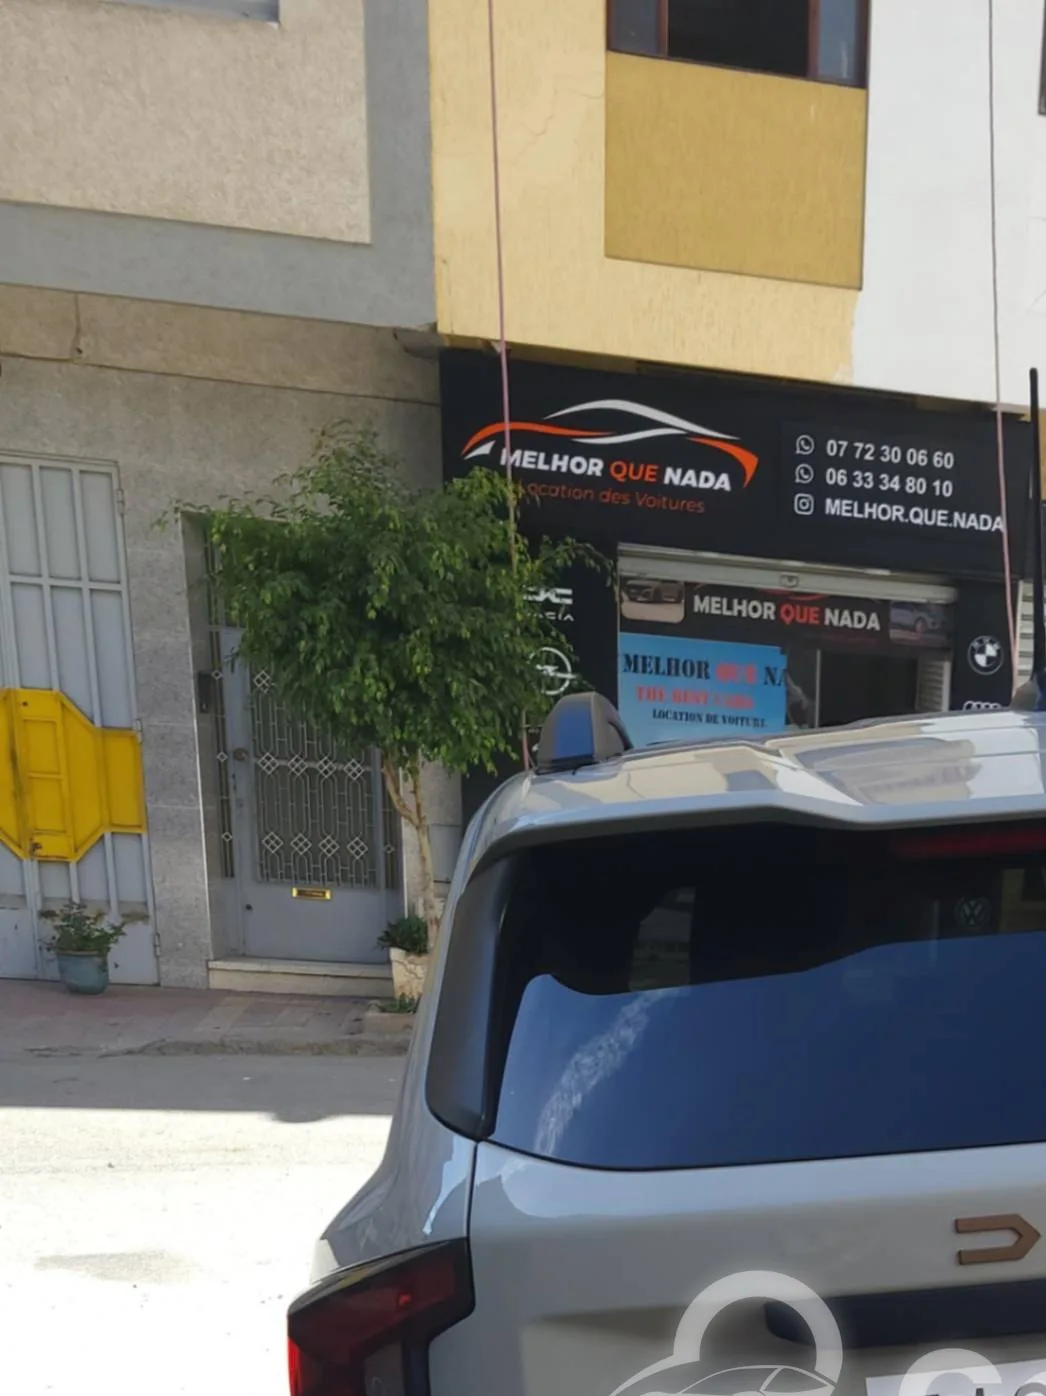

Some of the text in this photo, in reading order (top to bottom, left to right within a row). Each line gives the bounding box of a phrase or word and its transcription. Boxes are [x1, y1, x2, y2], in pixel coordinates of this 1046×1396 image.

[826, 440, 955, 469] 07 72 30 06 60
[500, 448, 731, 491] MELHOR QUE NADA
[825, 468, 953, 497] 06 33 34 80 10
[518, 480, 705, 514] ocation des Voitures
[693, 593, 881, 631] MELHOR QUE NADA
[623, 653, 710, 680] MELHOR
[652, 708, 703, 723] LOCATION
[705, 714, 718, 724] DE
